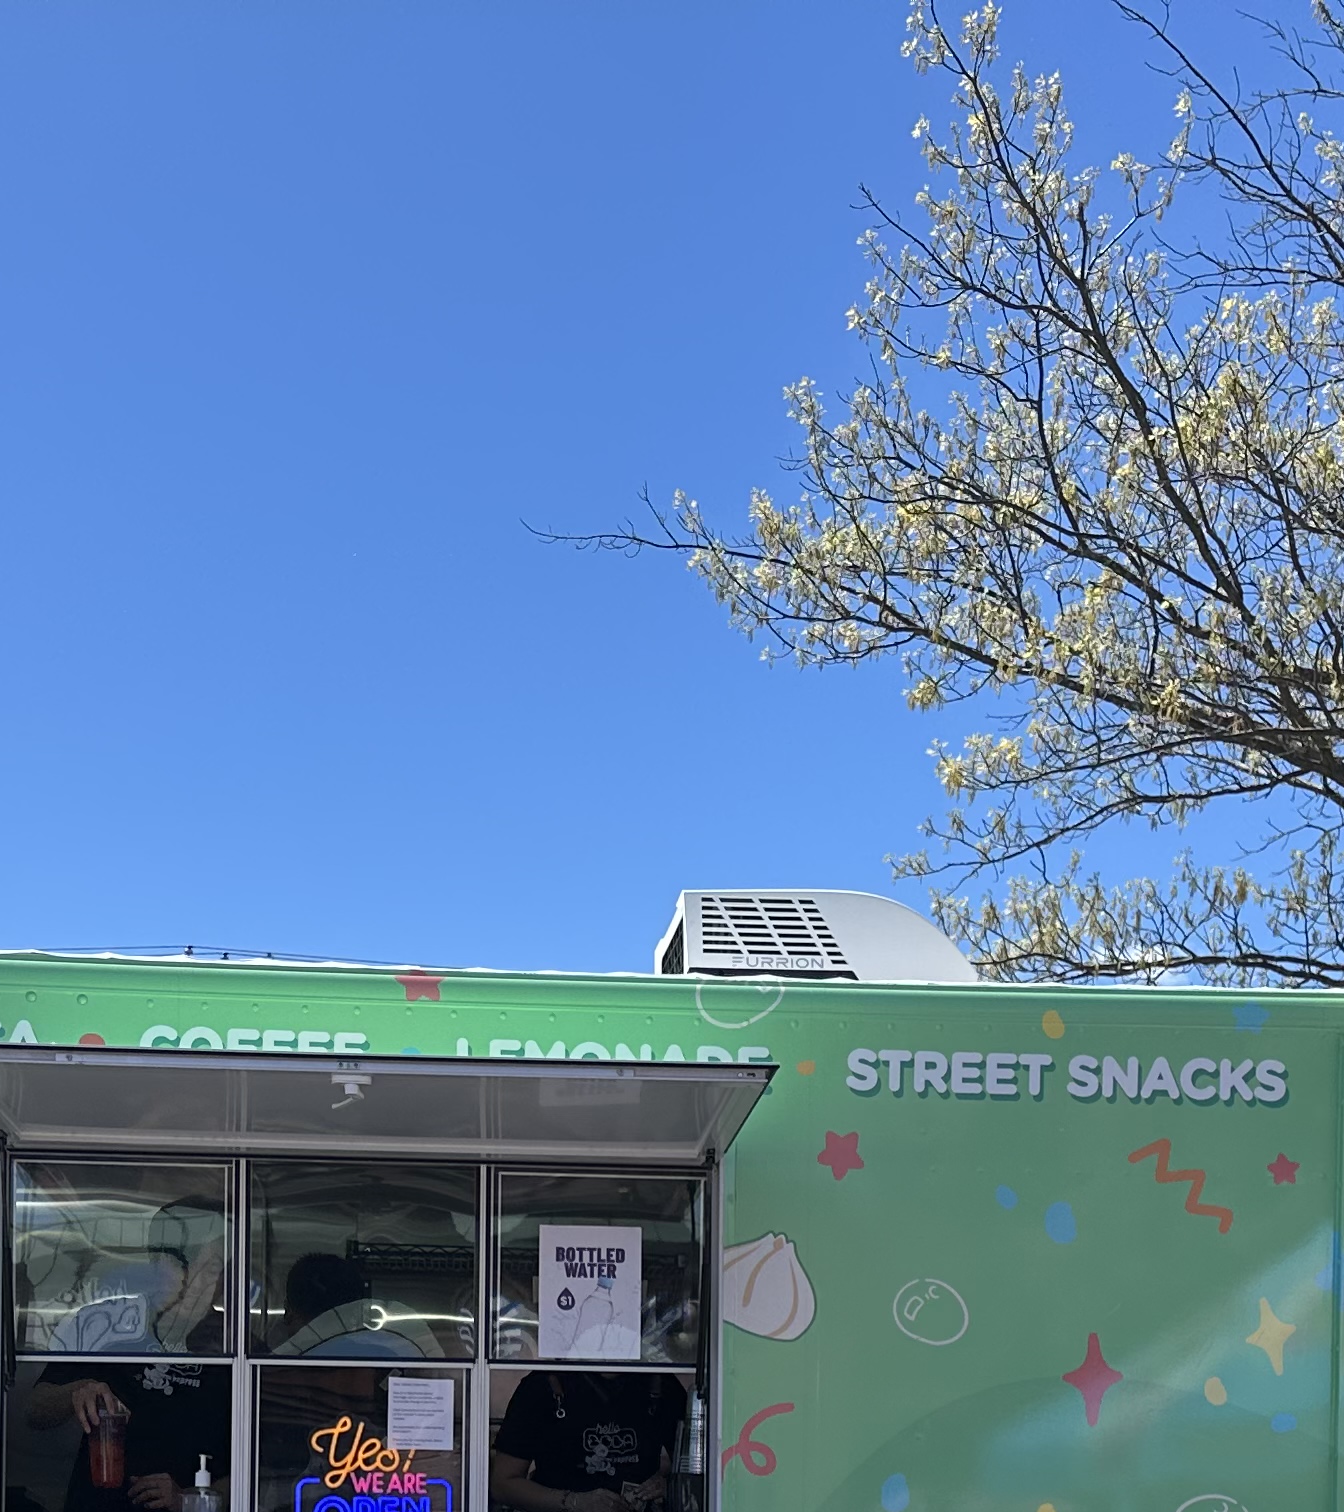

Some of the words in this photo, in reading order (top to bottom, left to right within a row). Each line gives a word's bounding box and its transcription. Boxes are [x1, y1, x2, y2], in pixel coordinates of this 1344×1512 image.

[731, 956, 825, 969] FURRION
[845, 1048, 1053, 1096] STREET
[1067, 1054, 1287, 1102] SNACKS
[556, 1246, 626, 1264] BOTTLED
[564, 1262, 617, 1279] WATER
[559, 1295, 573, 1307] $1
[350, 1472, 385, 1494] WE
[386, 1472, 428, 1494] ARE
